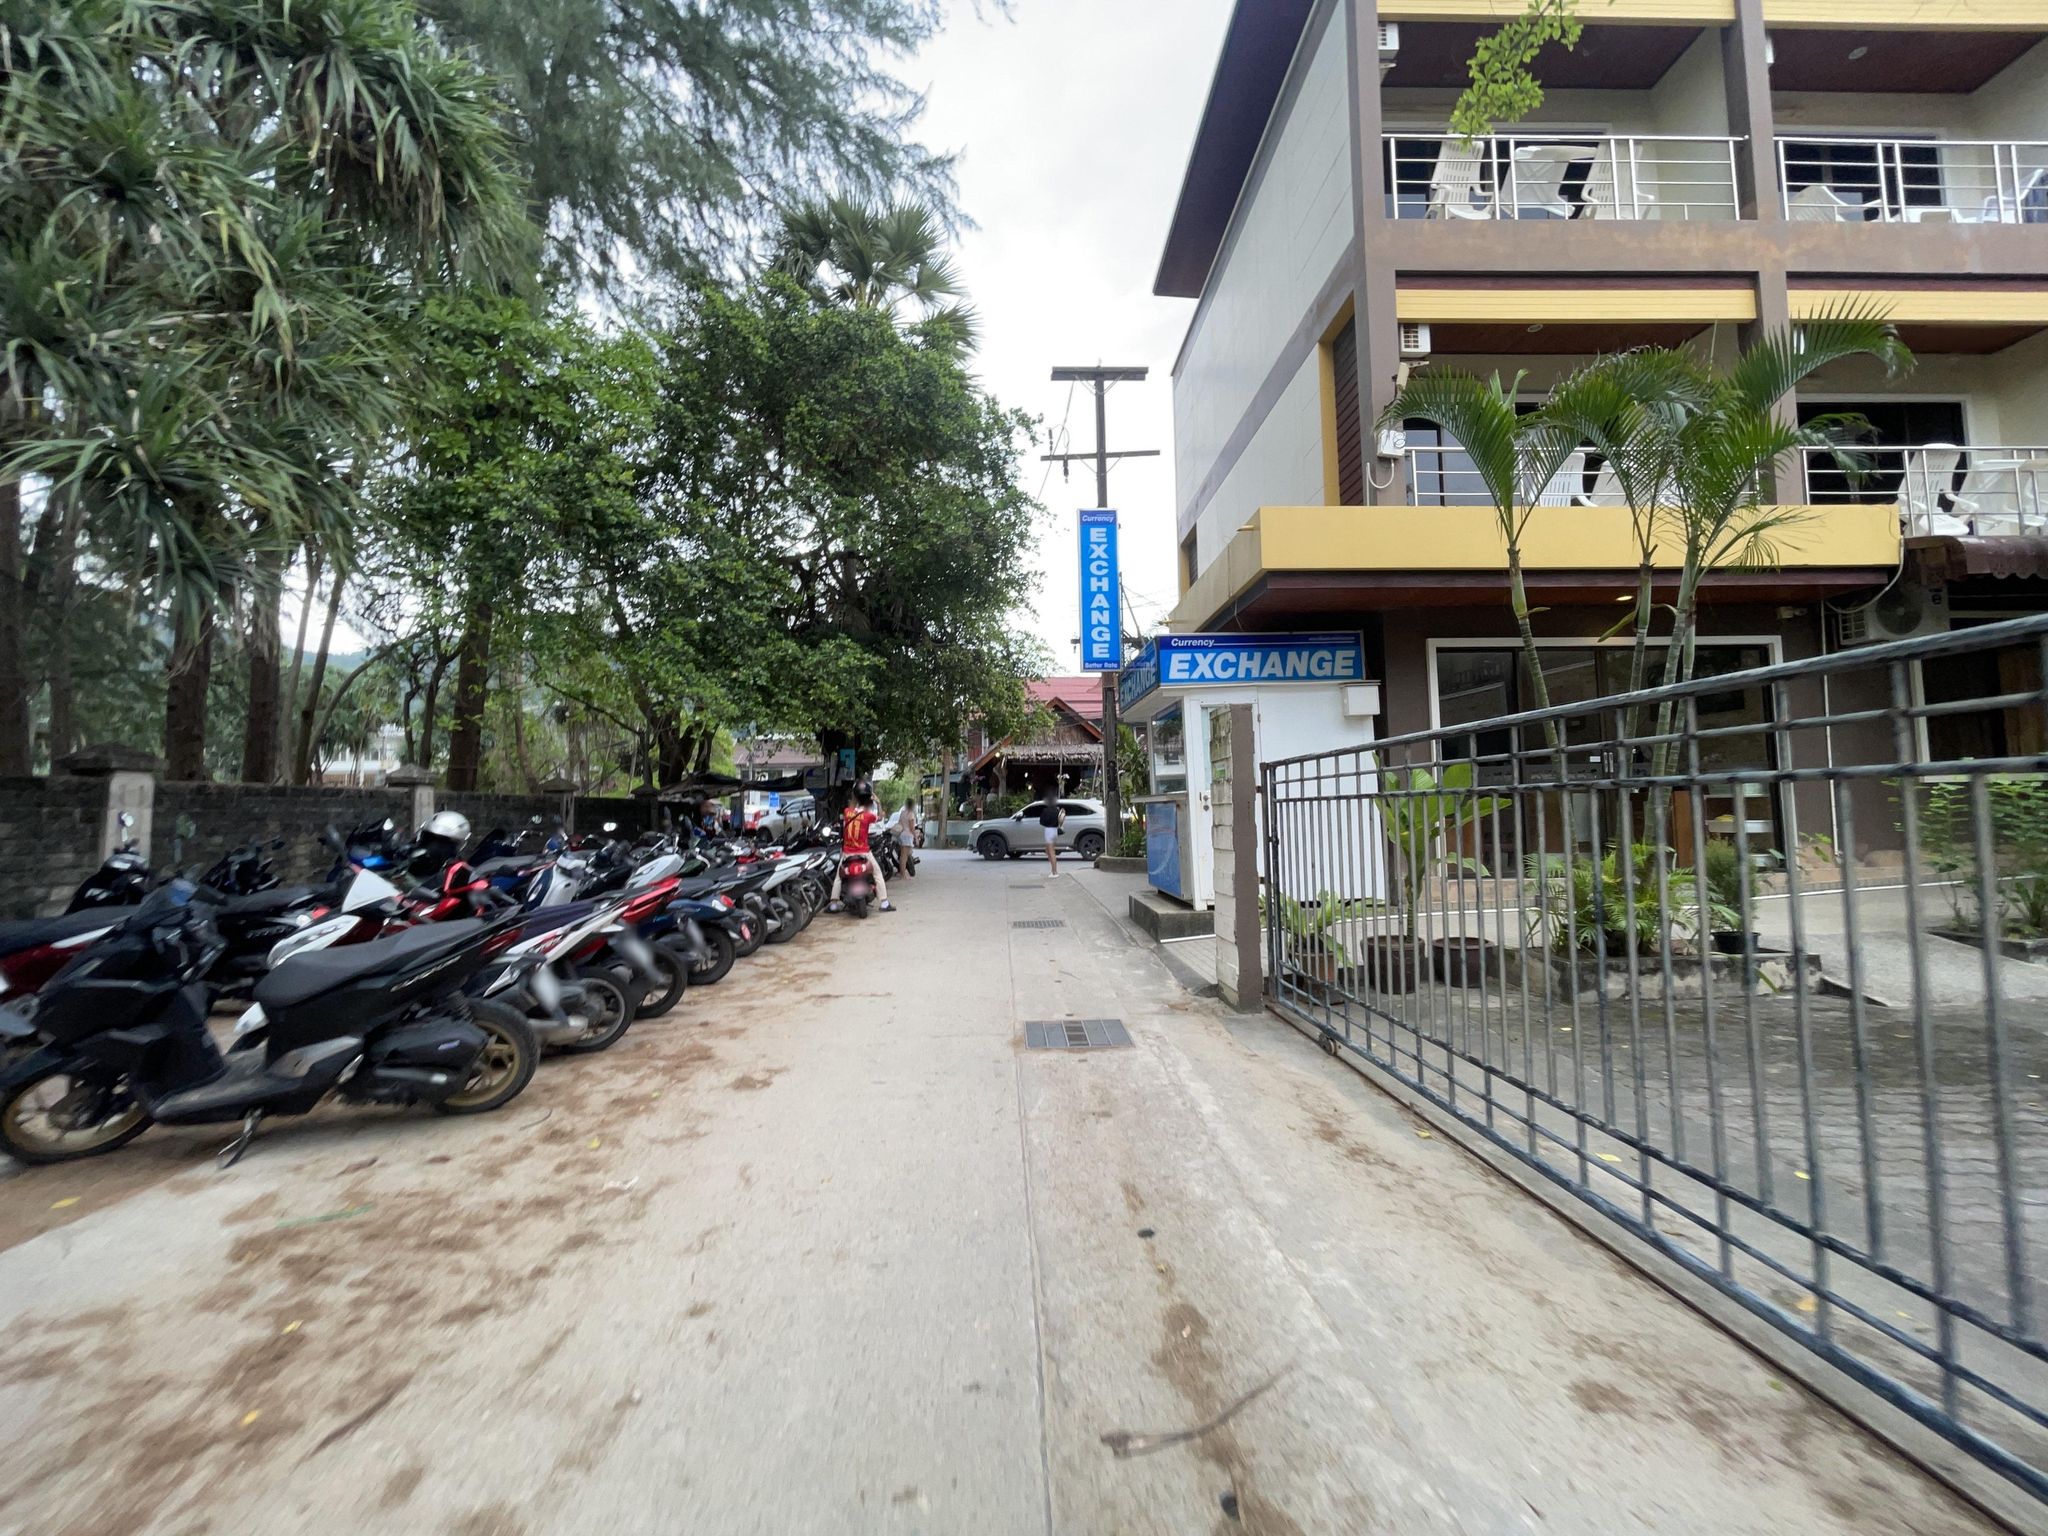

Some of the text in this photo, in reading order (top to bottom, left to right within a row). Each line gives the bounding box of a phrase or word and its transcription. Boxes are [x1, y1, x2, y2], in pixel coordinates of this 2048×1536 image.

[1082, 514, 1115, 523] Currency
[1089, 527, 1111, 659] EXCHANGE
[1171, 638, 1215, 648] Currency
[1168, 650, 1356, 680] EXCHANGE
